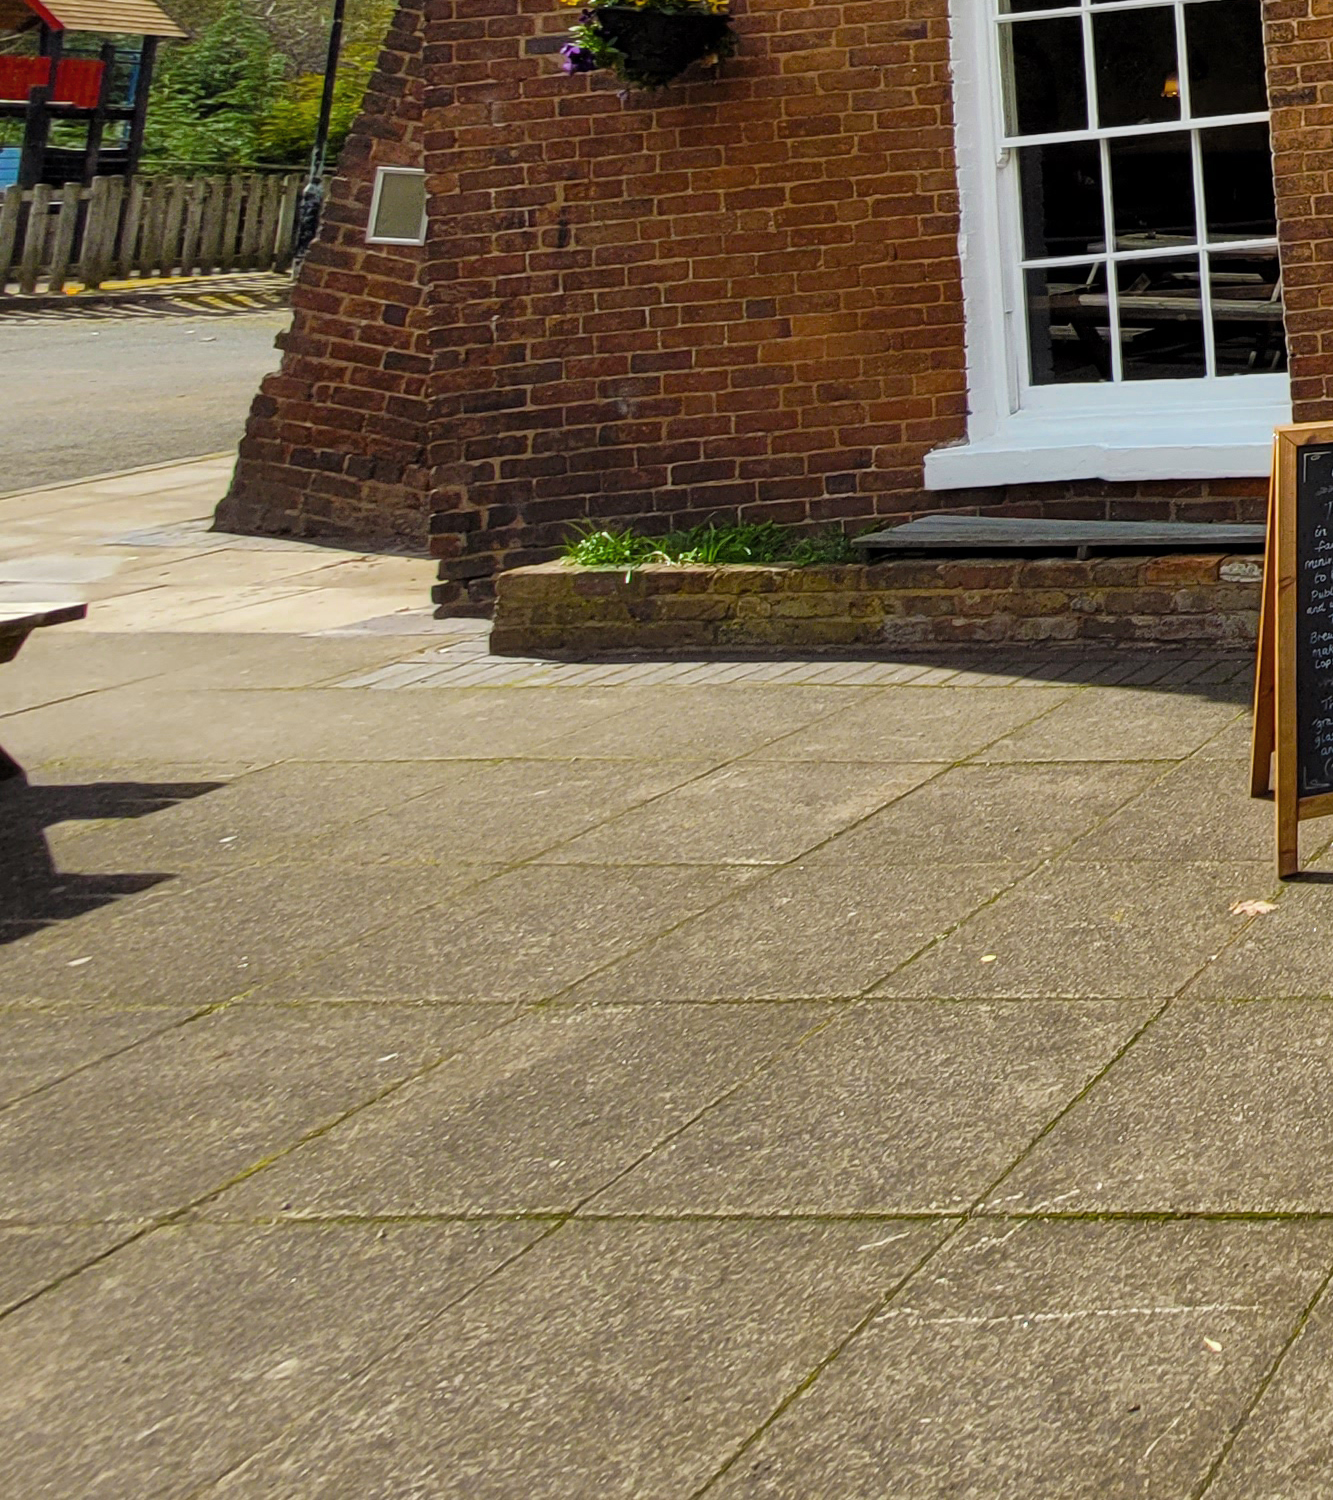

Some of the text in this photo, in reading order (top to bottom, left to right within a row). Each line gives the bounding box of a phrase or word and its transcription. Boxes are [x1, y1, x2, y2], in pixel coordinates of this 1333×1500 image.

[1315, 525, 1327, 537] in
[1314, 572, 1326, 584] to
[1306, 602, 1326, 615] and
